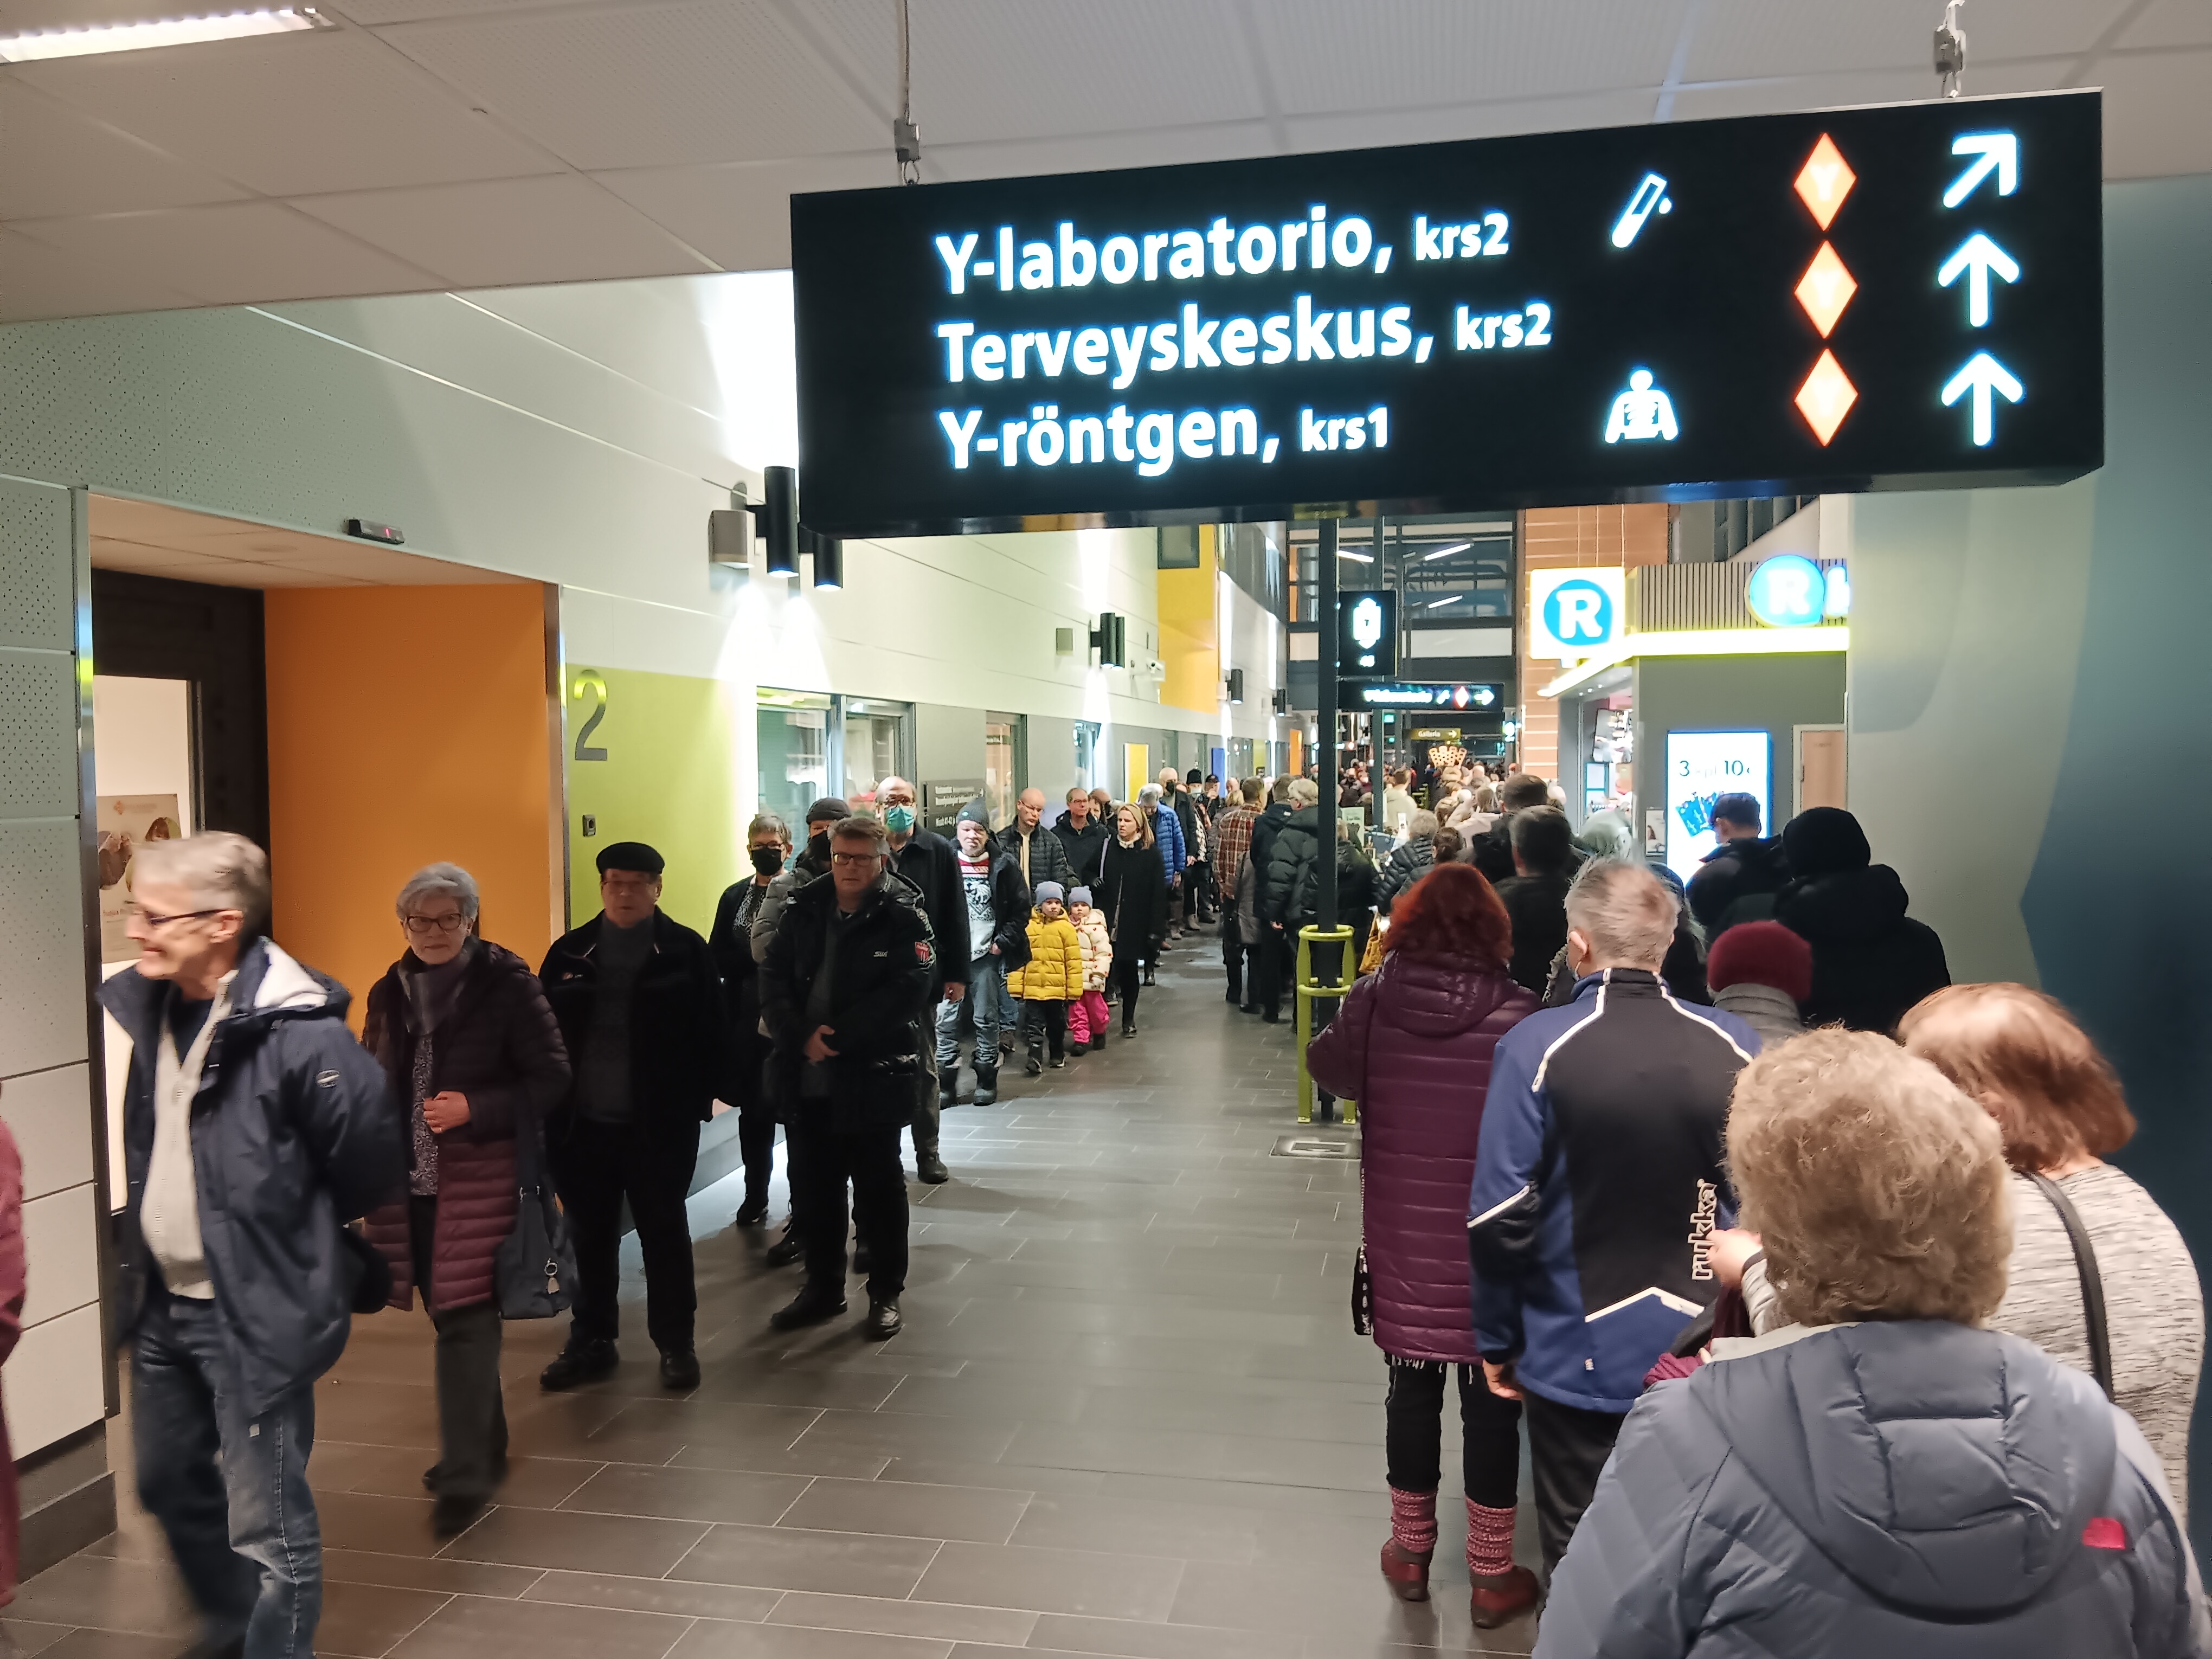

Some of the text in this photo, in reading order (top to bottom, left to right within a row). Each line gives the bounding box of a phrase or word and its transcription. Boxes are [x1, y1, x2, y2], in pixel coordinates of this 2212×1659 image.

[1809, 162, 1841, 202] Y
[935, 205, 1510, 294] Y-laboratorio, krs2
[1810, 269, 1842, 308] Y
[937, 295, 1552, 390] Terveyskeskus, krs2
[938, 404, 1388, 477] Y-röntgen, krs1
[1555, 588, 1603, 639] R
[574, 669, 608, 761] 2
[1679, 760, 1690, 776] 3
[1687, 1182, 1718, 1280] rukka
